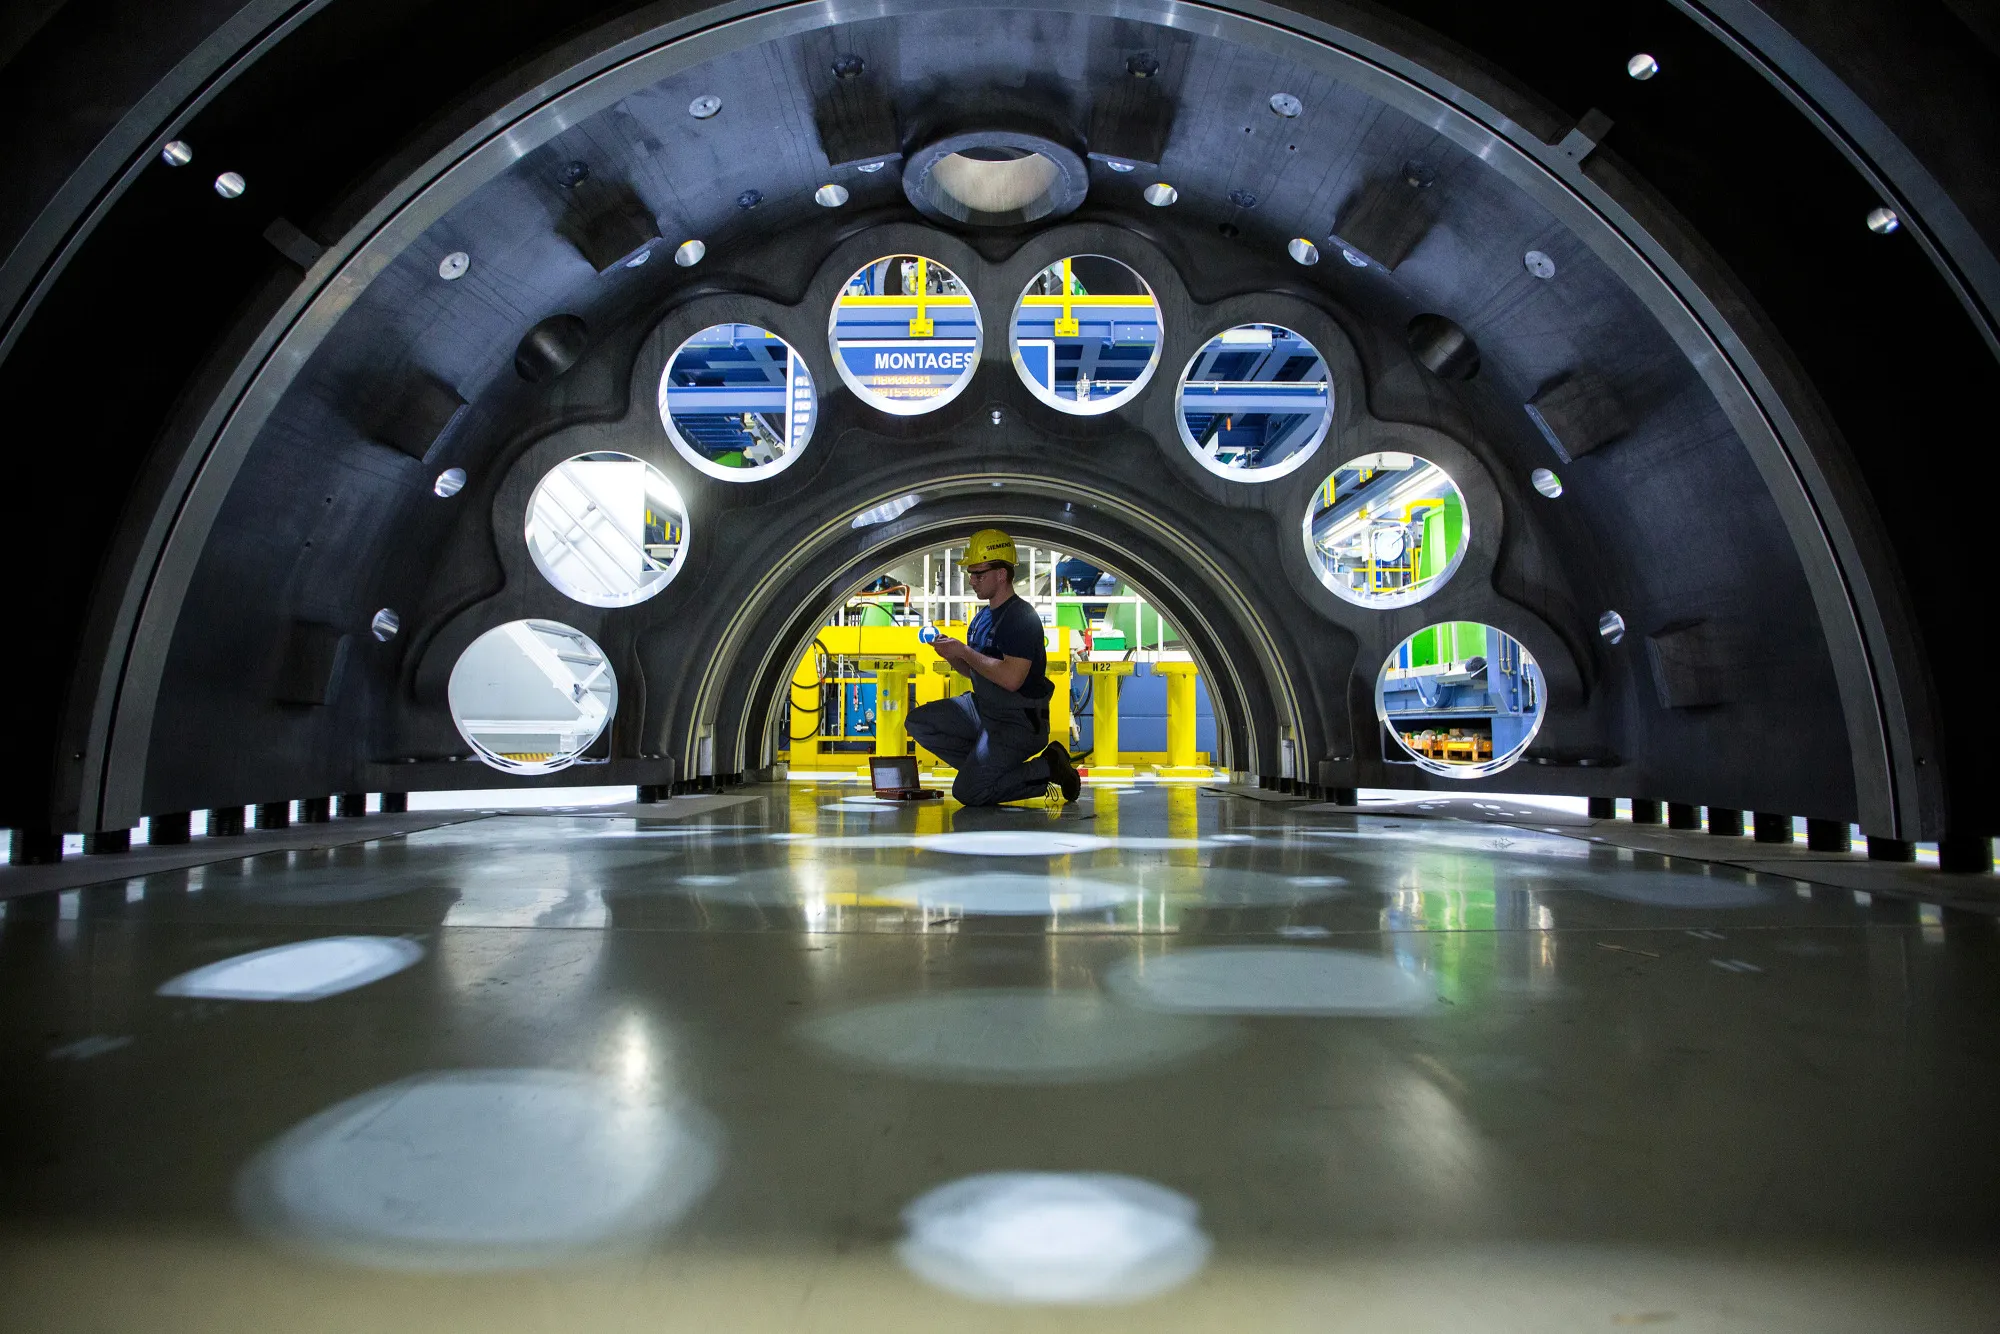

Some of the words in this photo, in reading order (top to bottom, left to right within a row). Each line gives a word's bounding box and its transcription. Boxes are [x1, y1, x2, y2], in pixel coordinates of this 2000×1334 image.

[986, 542, 1011, 551] SIEMENS
[883, 661, 894, 670] 22
[1100, 663, 1111, 671] 22
